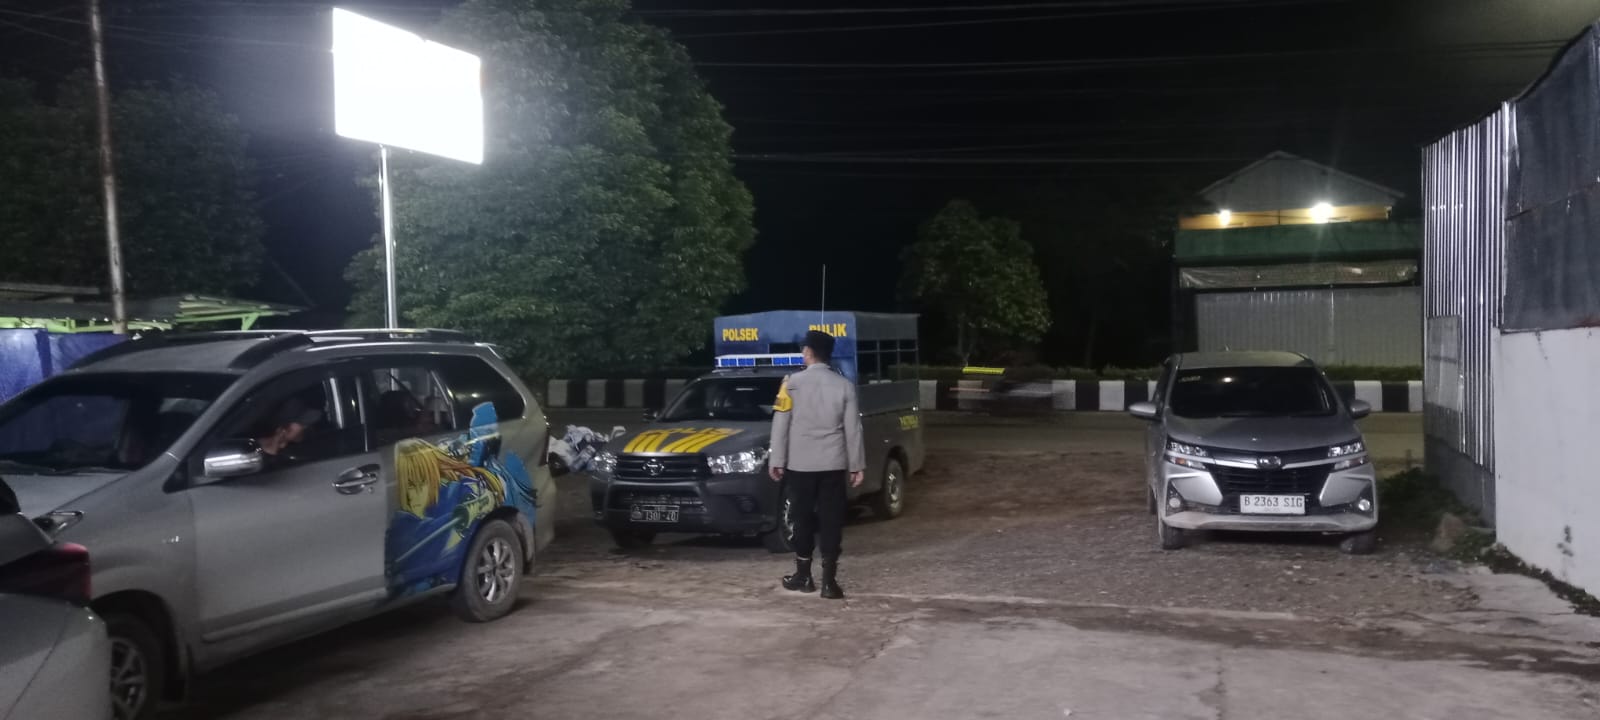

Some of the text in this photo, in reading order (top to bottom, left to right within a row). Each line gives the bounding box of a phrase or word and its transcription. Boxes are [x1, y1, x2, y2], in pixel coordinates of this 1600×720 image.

[722, 327, 759, 342] POLSEK
[1244, 496, 1303, 508] B 2363 SIG
